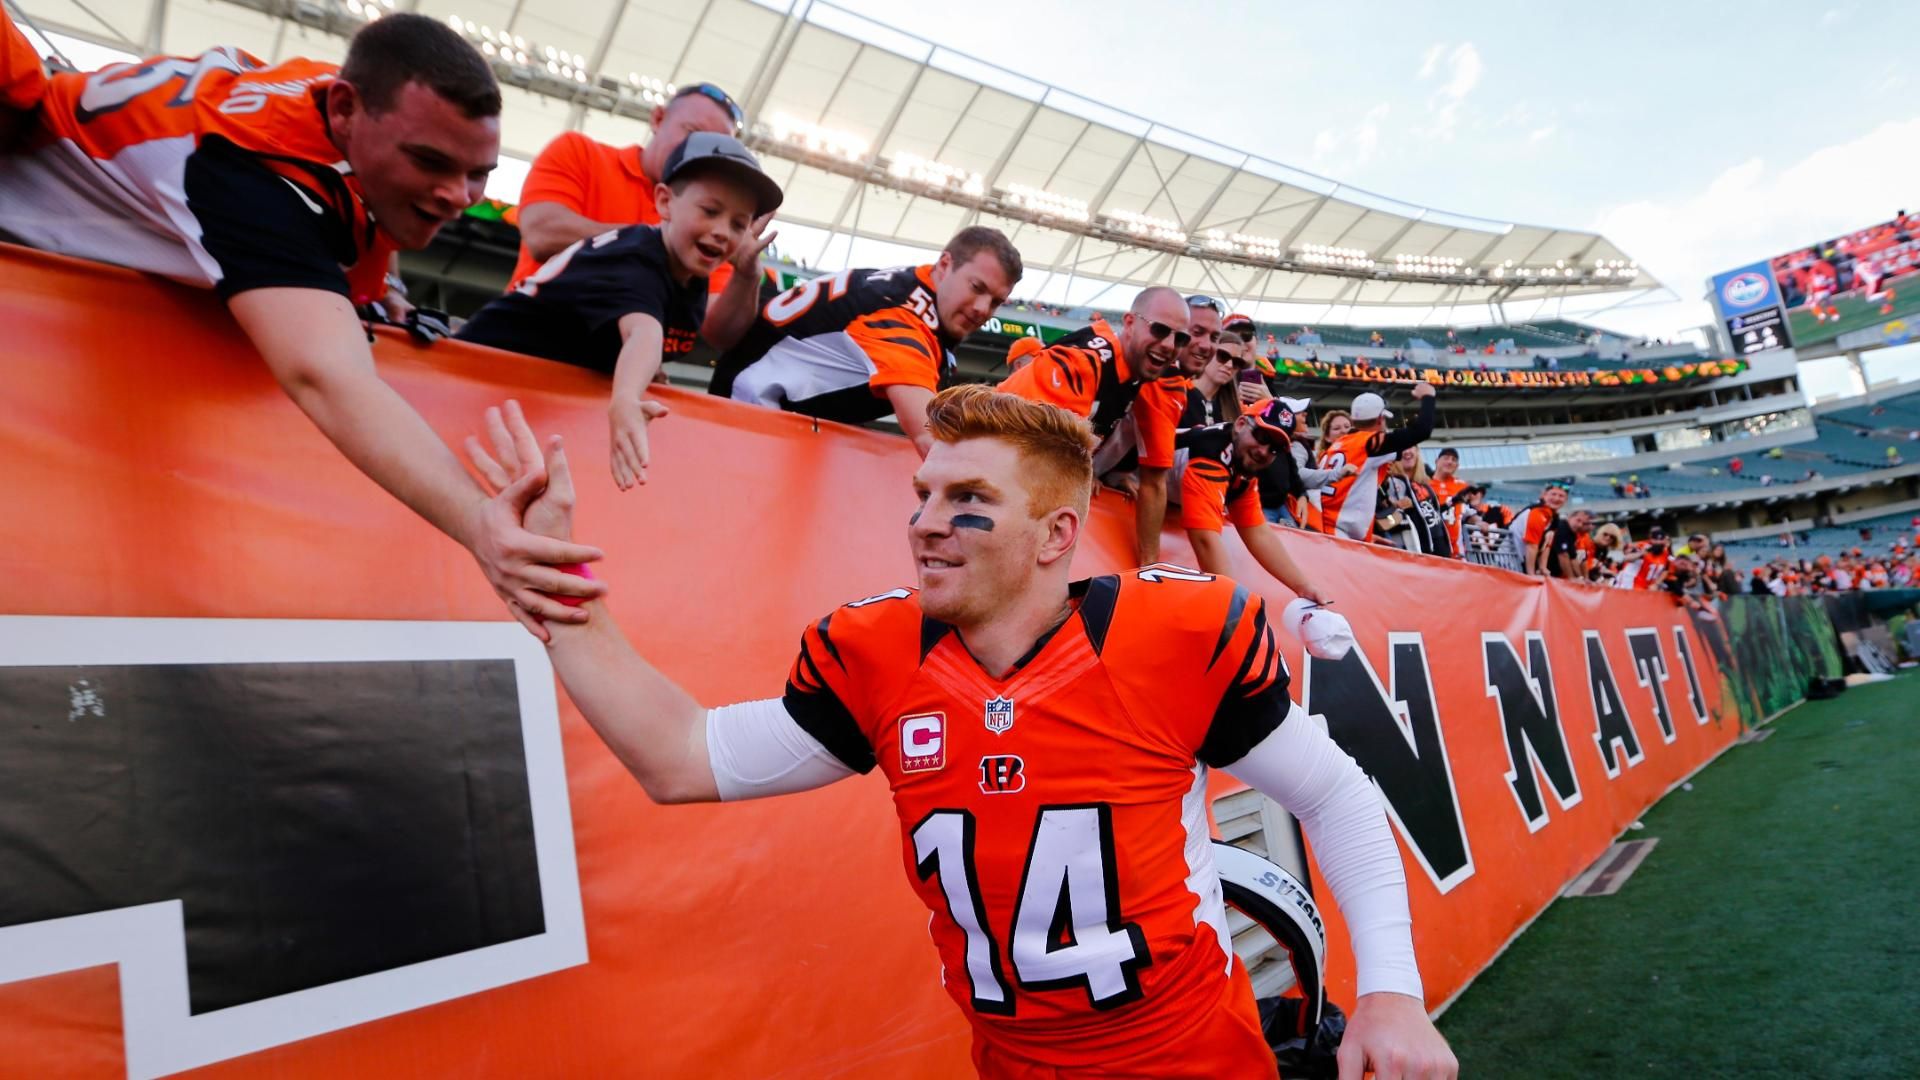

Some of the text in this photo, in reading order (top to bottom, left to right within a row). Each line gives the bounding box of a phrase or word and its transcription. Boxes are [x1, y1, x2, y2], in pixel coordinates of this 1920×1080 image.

[1087, 336, 1113, 363] 94
[1472, 371, 1513, 386] OUR
[988, 713, 1010, 727] NFL
[902, 716, 943, 757] C
[910, 803, 1153, 1017] 14
